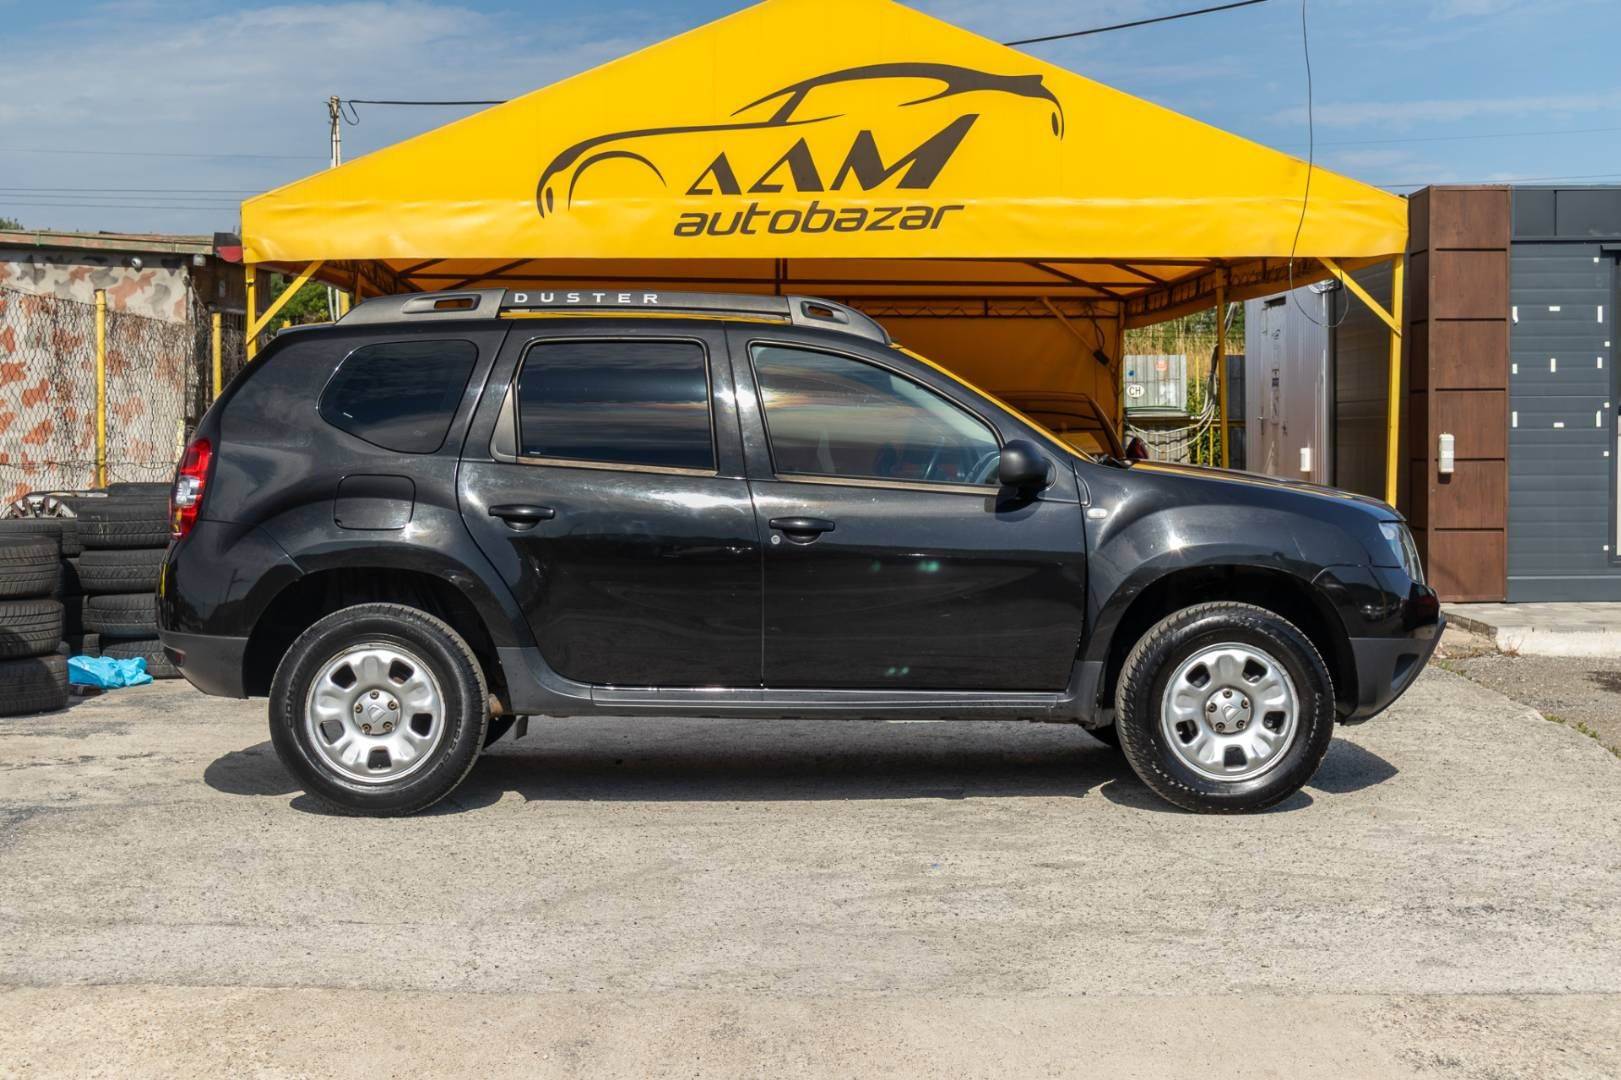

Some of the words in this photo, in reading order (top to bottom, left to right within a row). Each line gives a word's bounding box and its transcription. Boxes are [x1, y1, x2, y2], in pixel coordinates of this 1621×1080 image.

[685, 113, 980, 195] AAM
[673, 200, 965, 237] autobazar
[514, 292, 658, 304] DUSTER
[1128, 386, 1141, 396] CH
